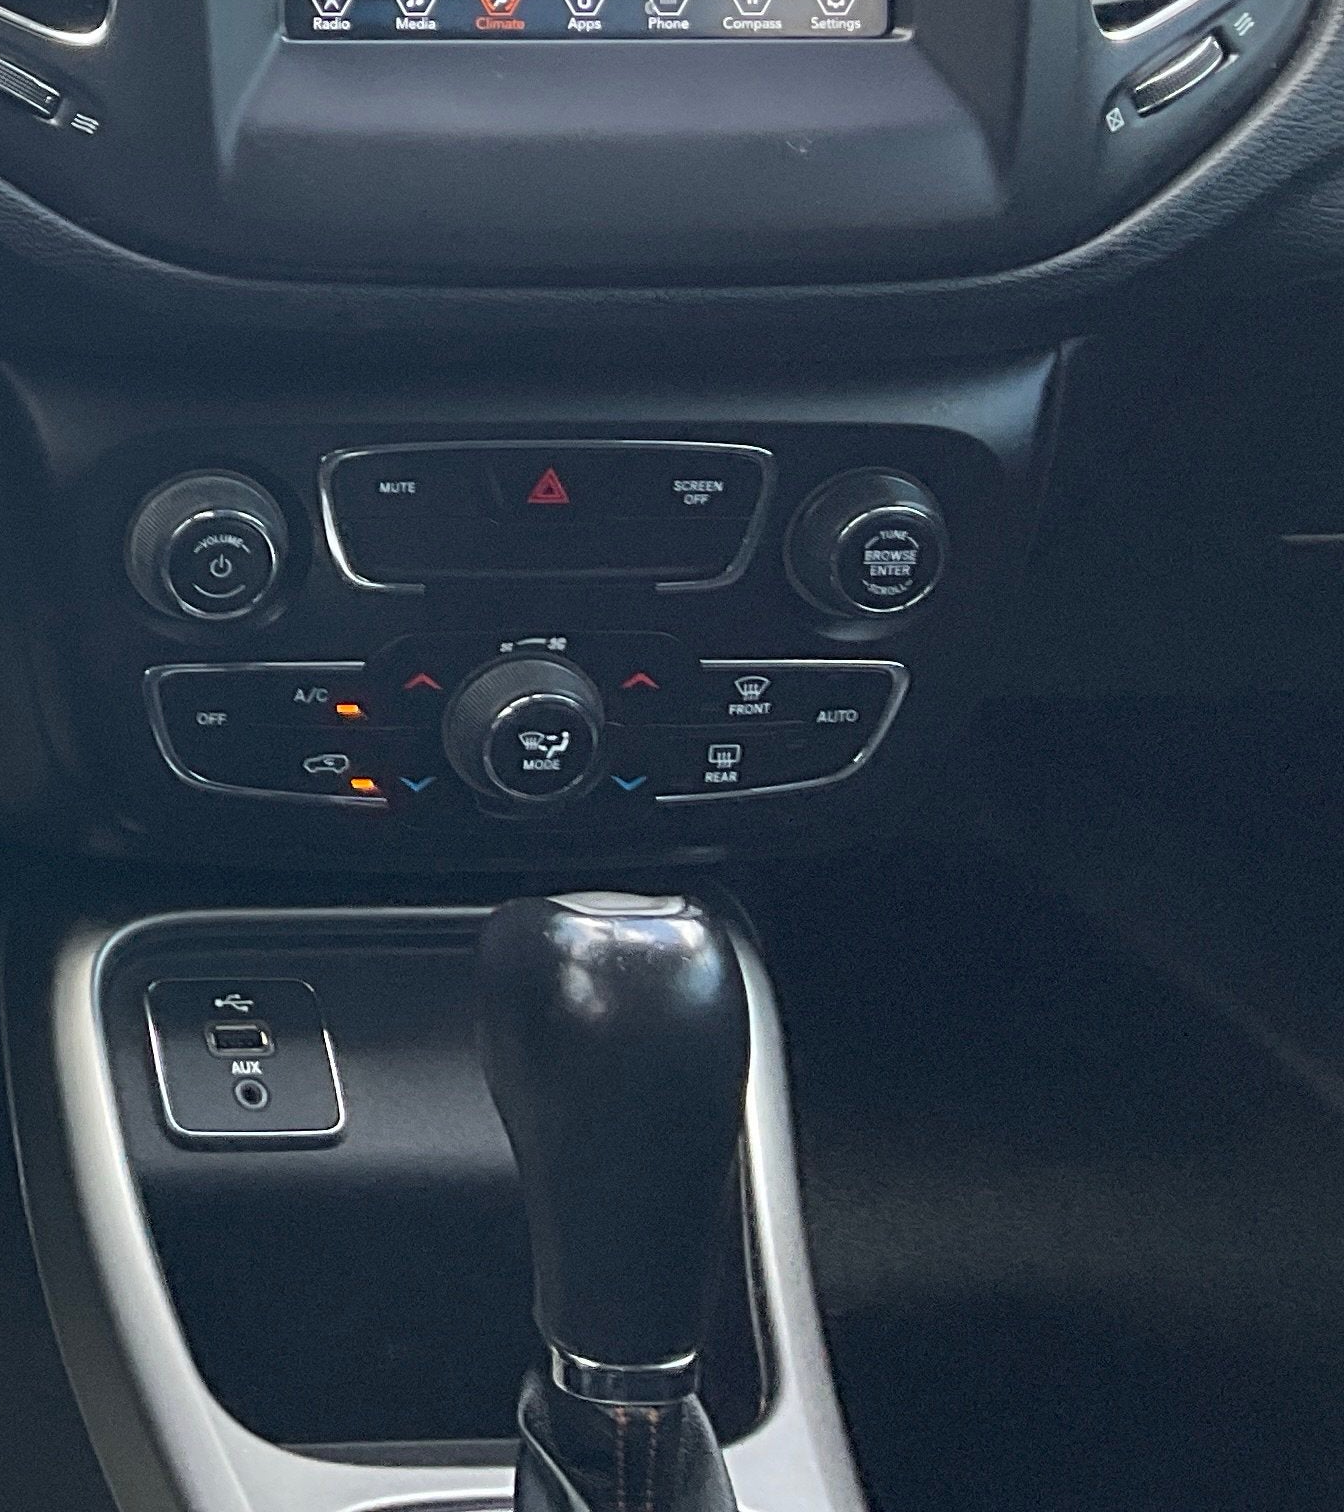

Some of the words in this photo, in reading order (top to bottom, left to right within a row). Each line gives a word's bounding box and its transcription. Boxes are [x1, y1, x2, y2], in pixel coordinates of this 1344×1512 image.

[313, 17, 351, 30] Radio
[395, 17, 436, 30] Media
[475, 17, 525, 30] Climate
[567, 17, 602, 31] Apps
[648, 17, 689, 30] Phone
[723, 17, 782, 31] Compass
[811, 17, 861, 31] Settings
[379, 482, 415, 494] MUTE
[672, 480, 723, 493] SCREEN
[683, 493, 709, 505] OFF
[200, 534, 244, 549] VOLUME
[864, 550, 917, 561] BROWSE
[870, 565, 911, 577] ENTER
[293, 688, 329, 703] A/C
[728, 702, 771, 715] FRONT
[196, 712, 227, 726] OFF
[816, 709, 859, 723] AUTO
[523, 759, 561, 771] MODE
[704, 771, 738, 783] REAR
[231, 1060, 263, 1075] AUX
